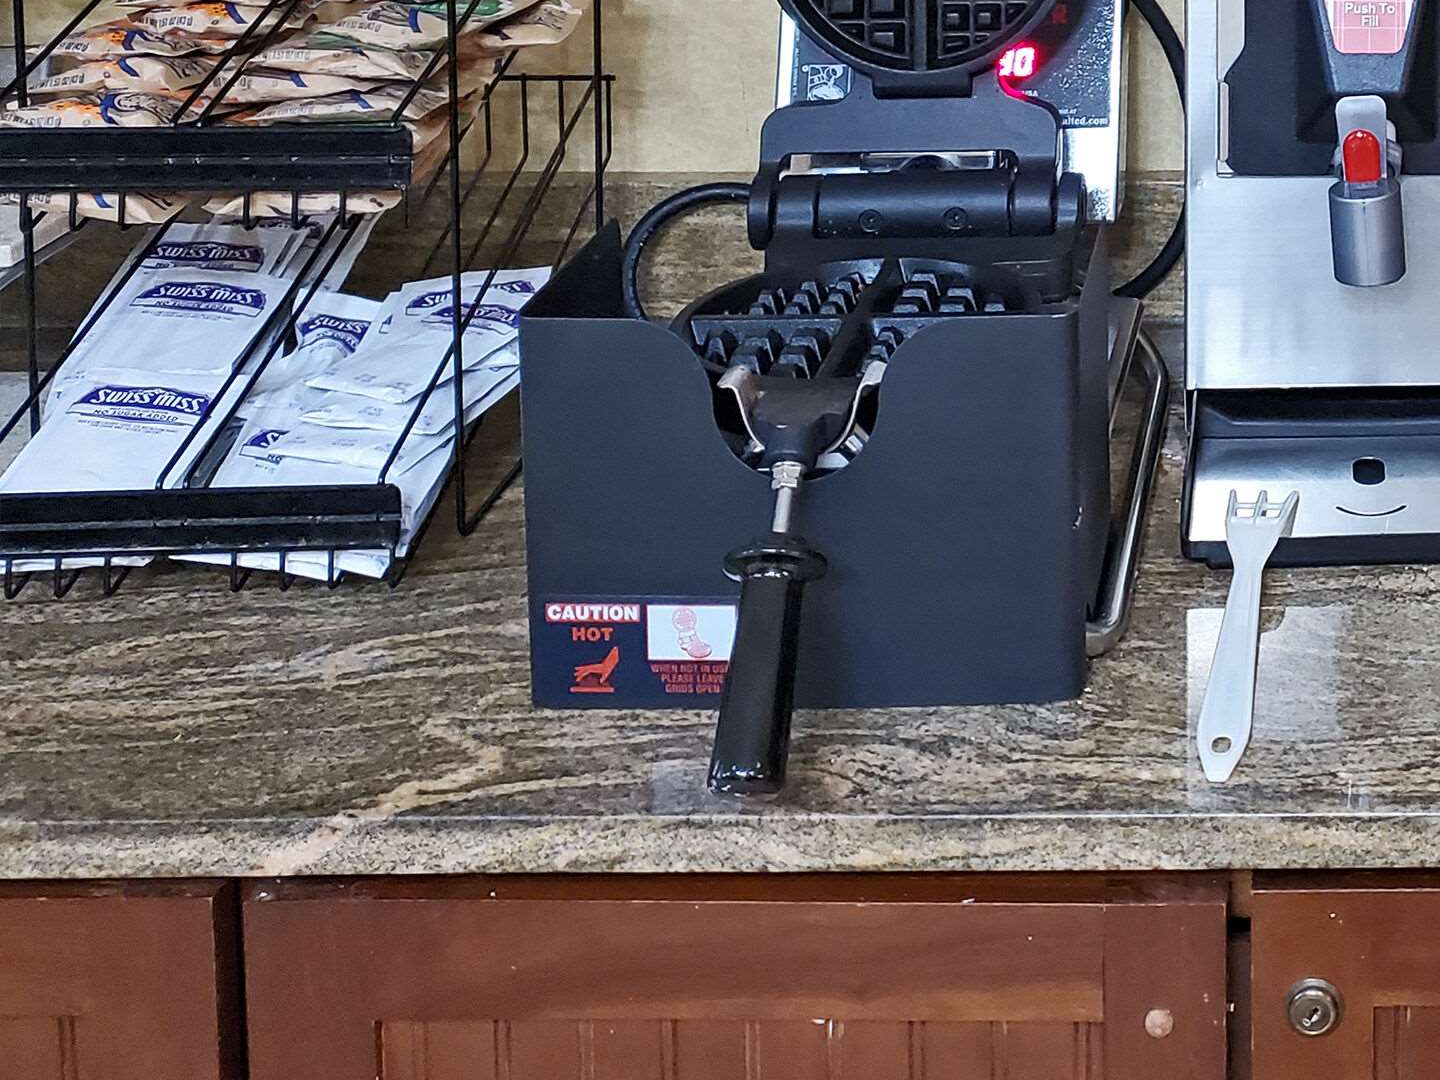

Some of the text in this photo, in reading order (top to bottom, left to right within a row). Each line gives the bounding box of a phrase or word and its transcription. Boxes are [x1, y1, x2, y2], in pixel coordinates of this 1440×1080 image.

[1344, 2, 1396, 14] Push To
[1361, 16, 1379, 27] Fill
[152, 285, 258, 305] SWISS MISS
[308, 317, 363, 334] SWISS
[89, 388, 205, 412] SWISS MISS
[547, 605, 640, 621] CAUTION
[571, 627, 614, 642] HOT
